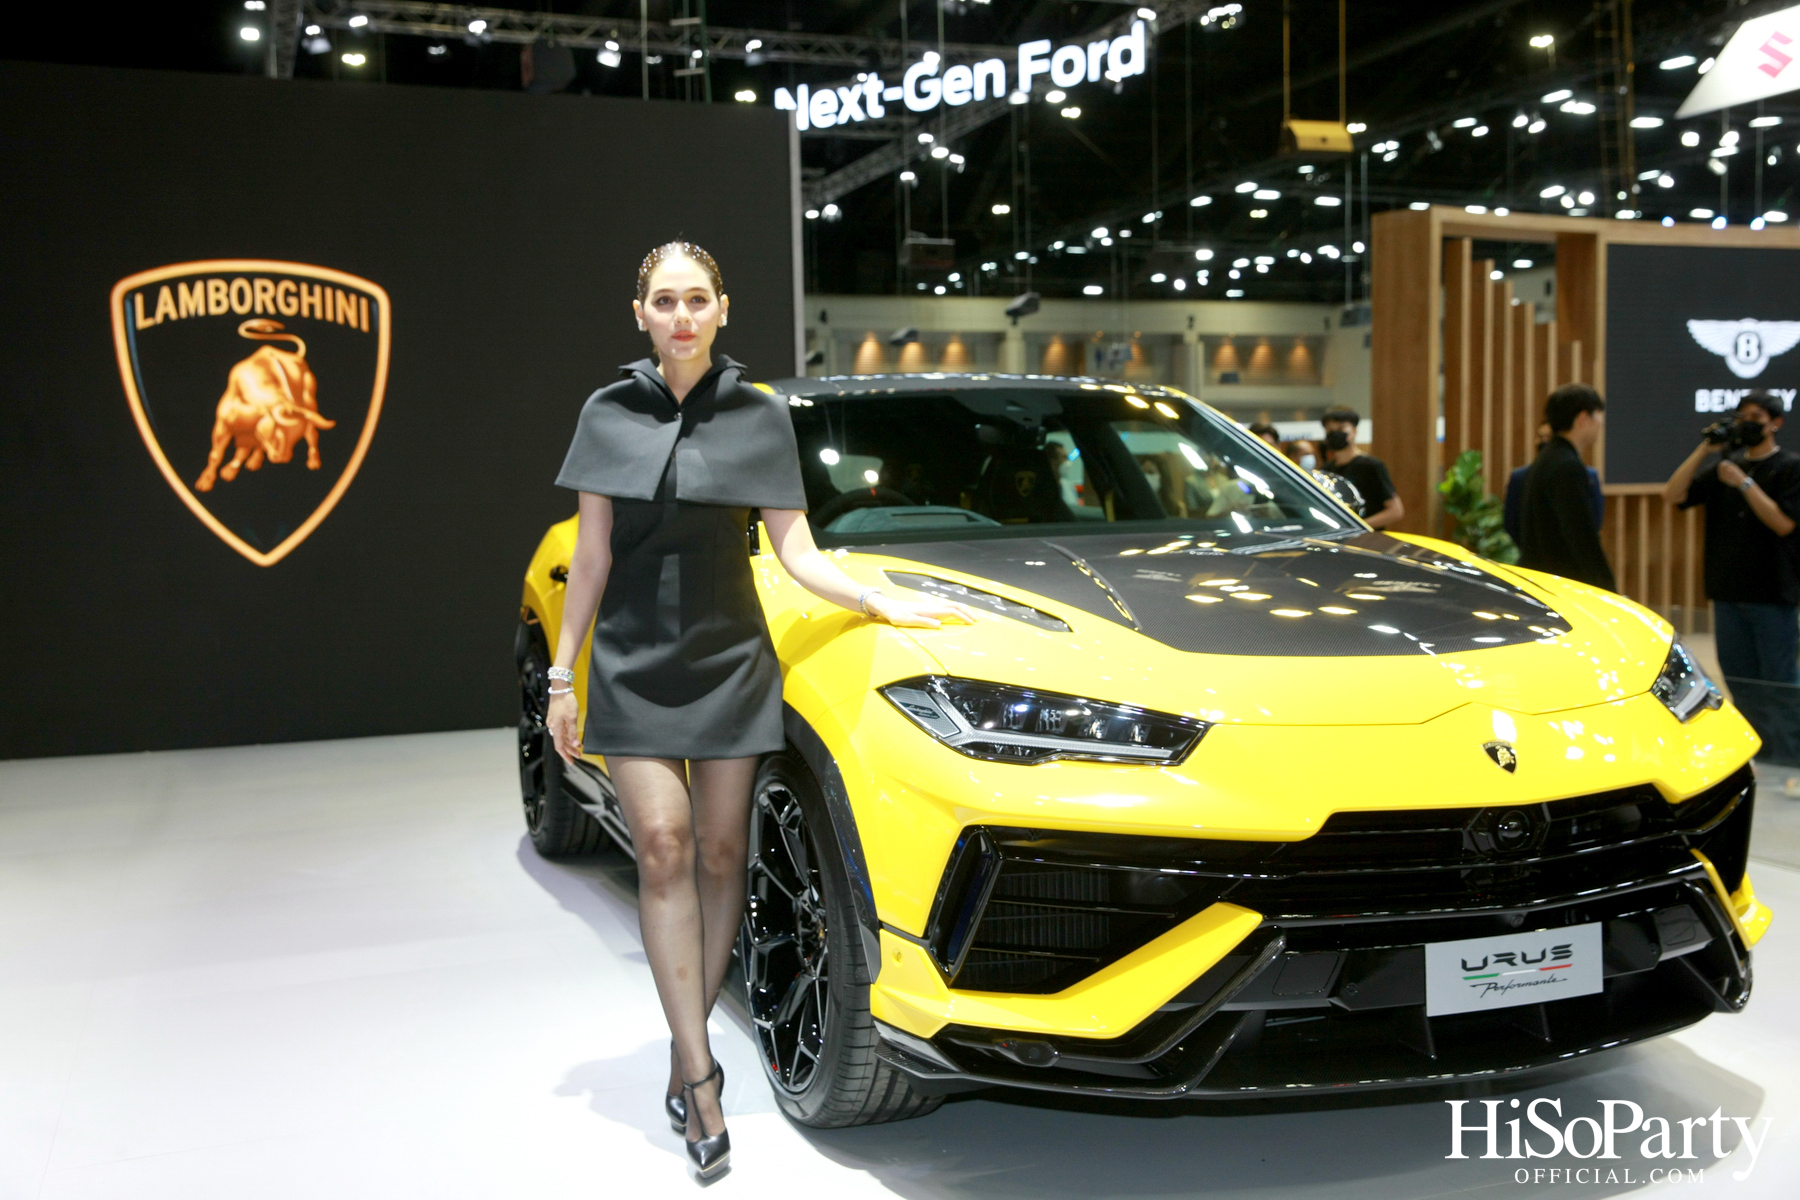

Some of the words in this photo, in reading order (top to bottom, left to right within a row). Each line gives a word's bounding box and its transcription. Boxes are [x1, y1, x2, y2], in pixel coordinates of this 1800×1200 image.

[774, 57, 1006, 131] Next-Gen
[1018, 20, 1145, 92] Ford
[134, 277, 369, 333] LAMBORGHINI
[1461, 943, 1573, 972] URUS
[1469, 974, 1567, 998] Performante
